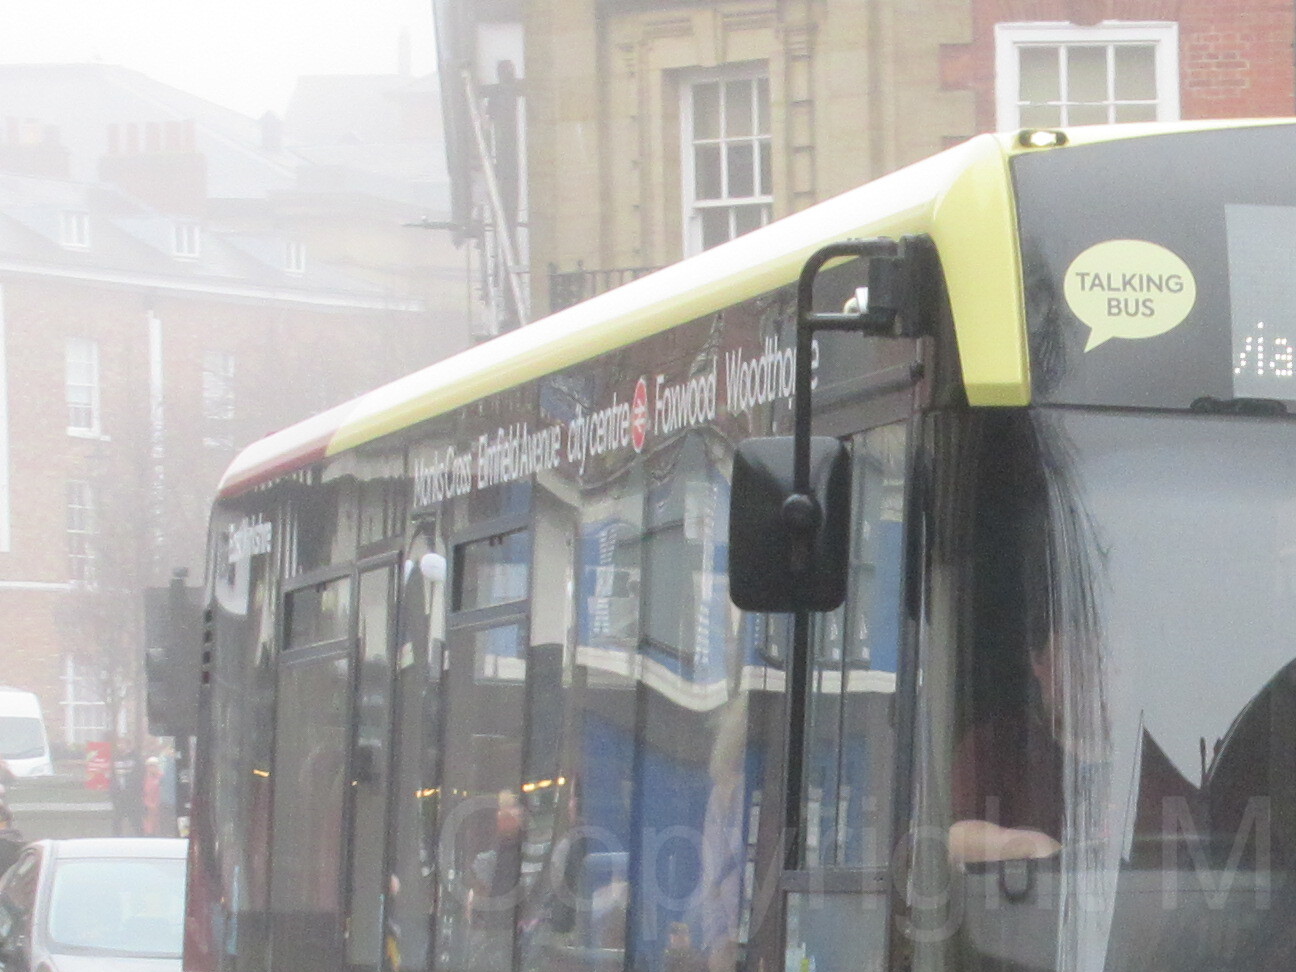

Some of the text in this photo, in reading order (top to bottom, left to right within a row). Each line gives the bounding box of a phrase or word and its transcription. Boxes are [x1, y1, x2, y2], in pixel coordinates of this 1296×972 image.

[1075, 271, 1185, 294] TALKING
[1106, 297, 1156, 318] BUS
[589, 391, 631, 454] centre
[654, 354, 718, 435] Foxwood
[726, 334, 819, 417] Woodthoe
